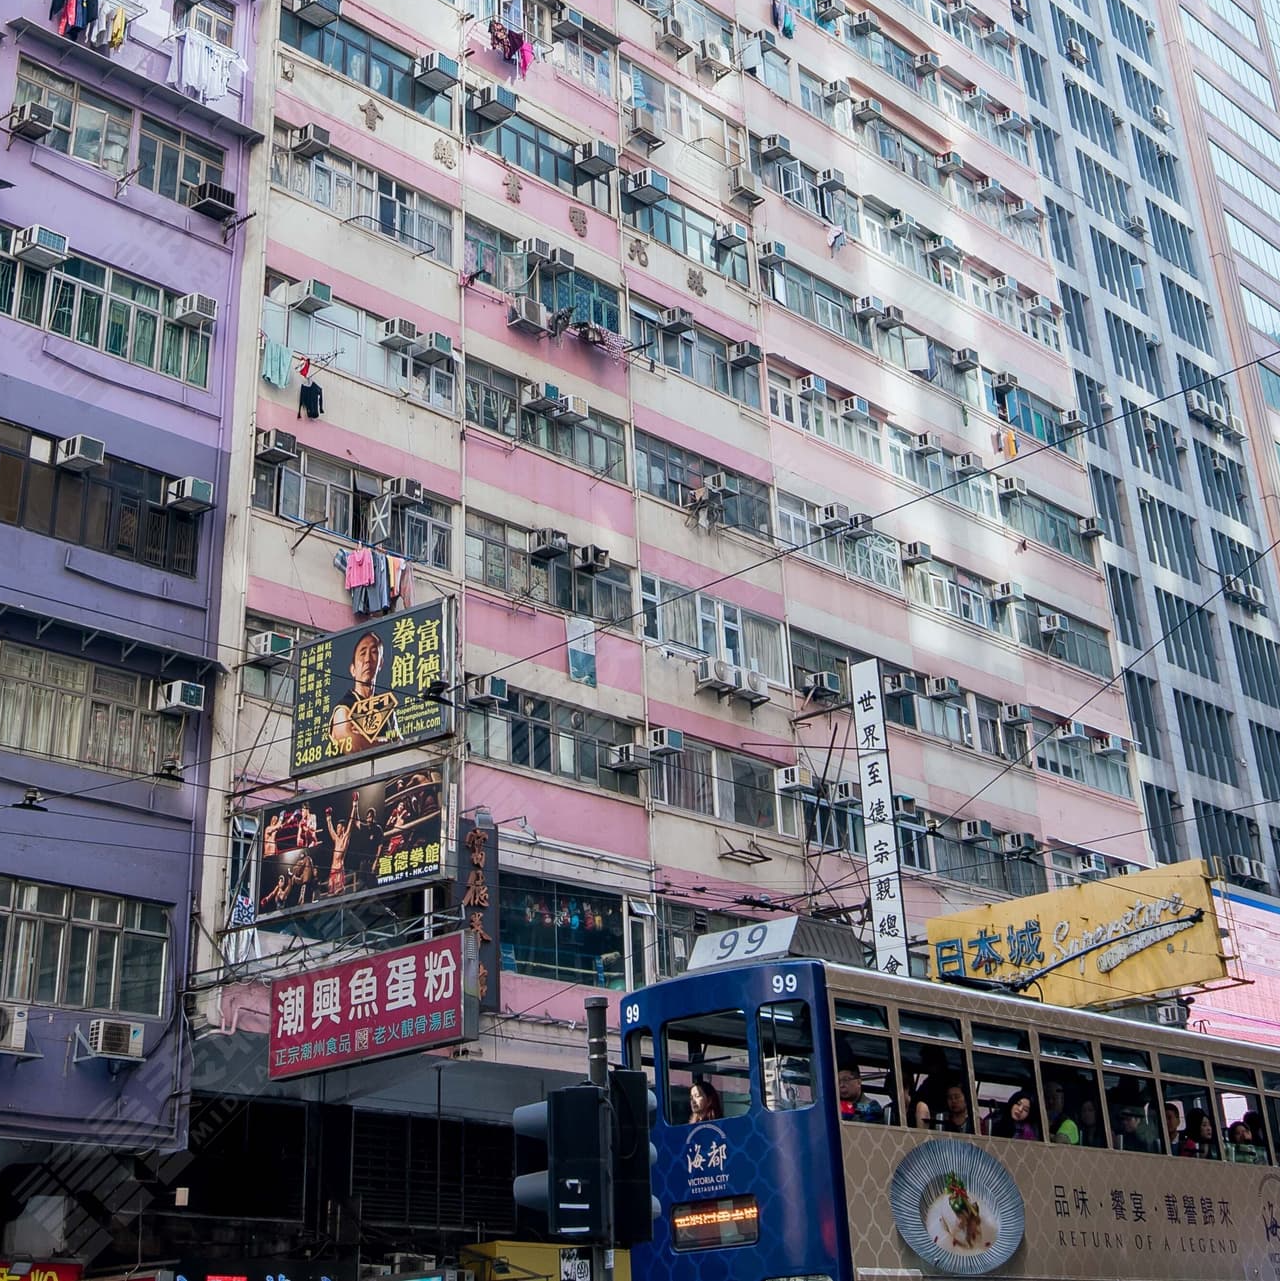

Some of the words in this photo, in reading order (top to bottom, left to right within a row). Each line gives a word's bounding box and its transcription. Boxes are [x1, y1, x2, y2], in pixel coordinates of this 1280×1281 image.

[391, 617, 415, 689] 拳館
[295, 745, 322, 767] 3488
[325, 736, 353, 758] 4378
[378, 842, 440, 877] 富德拳館
[716, 924, 769, 961] 99
[935, 918, 1045, 978] 日本城
[277, 948, 457, 1039] 潮興魚蛋粉
[772, 974, 798, 994] 99
[373, 1009, 457, 1046] 老火靚骨湯底
[626, 1003, 640, 1024] 99
[275, 1033, 352, 1067] 正宗潮州食品
[688, 1176, 716, 1187] VICTORIA
[718, 1173, 730, 1185] CITY
[691, 1183, 727, 1195] RESTAURANT
[1058, 1230, 1124, 1249] RETURN
[1135, 1234, 1153, 1251] OF
[1164, 1235, 1170, 1251] A
[1180, 1237, 1239, 1255] LEGEND
